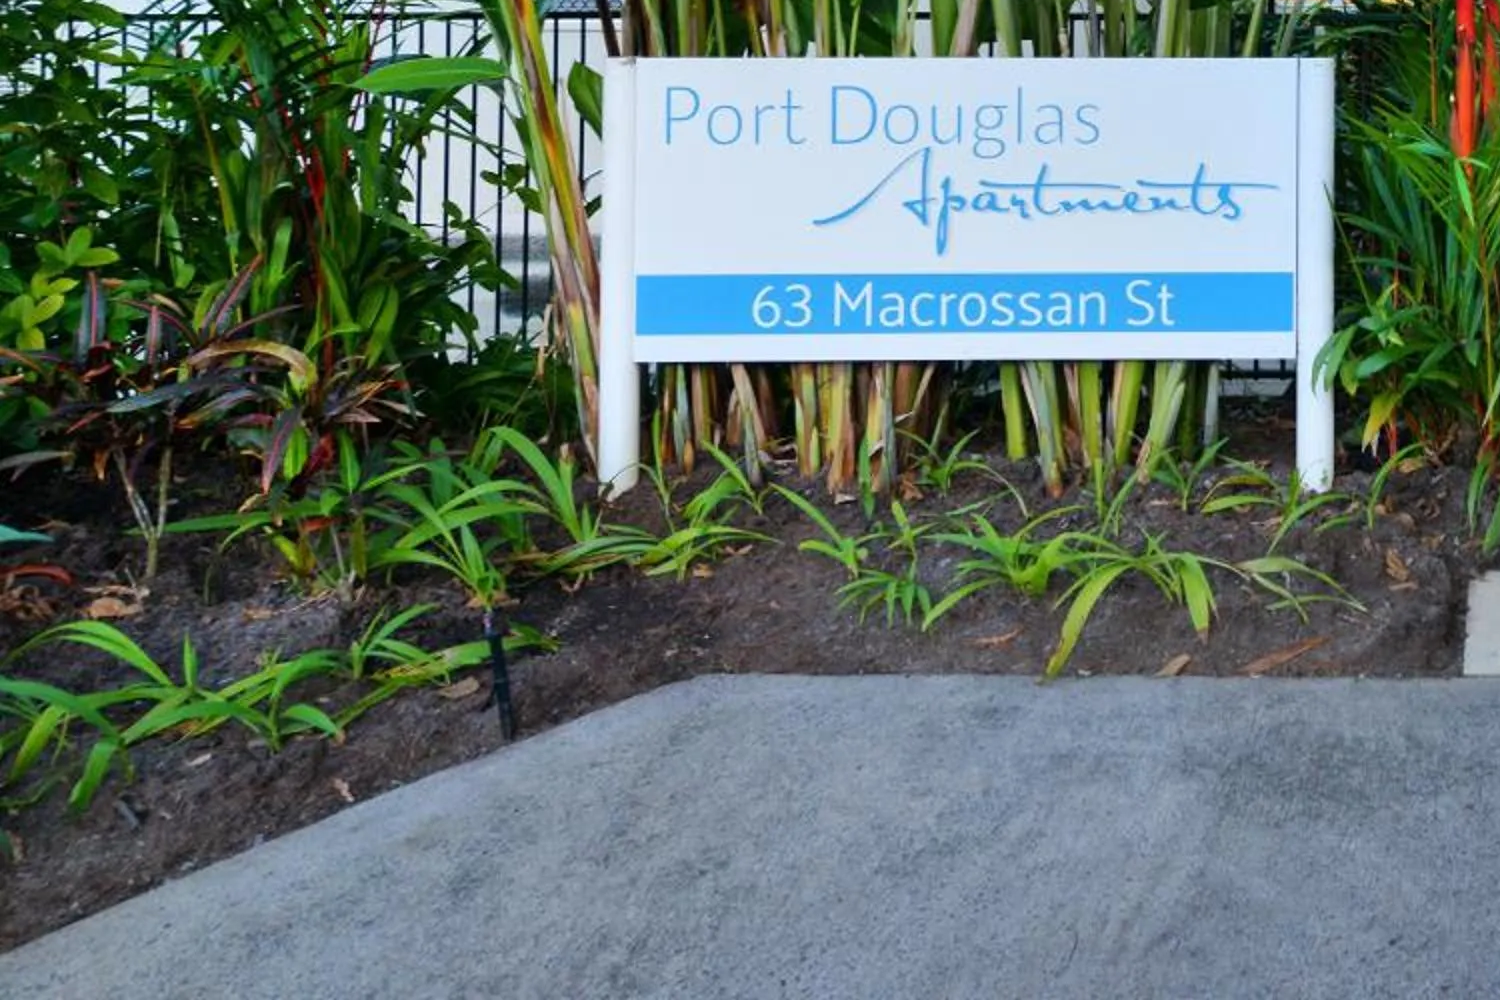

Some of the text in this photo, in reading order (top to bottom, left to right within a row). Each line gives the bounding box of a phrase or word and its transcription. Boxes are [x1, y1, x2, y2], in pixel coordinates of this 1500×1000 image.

[663, 84, 1102, 161] Port Douglas
[812, 146, 1280, 257] Apartments
[751, 279, 1176, 329] 63 Macrossan St
